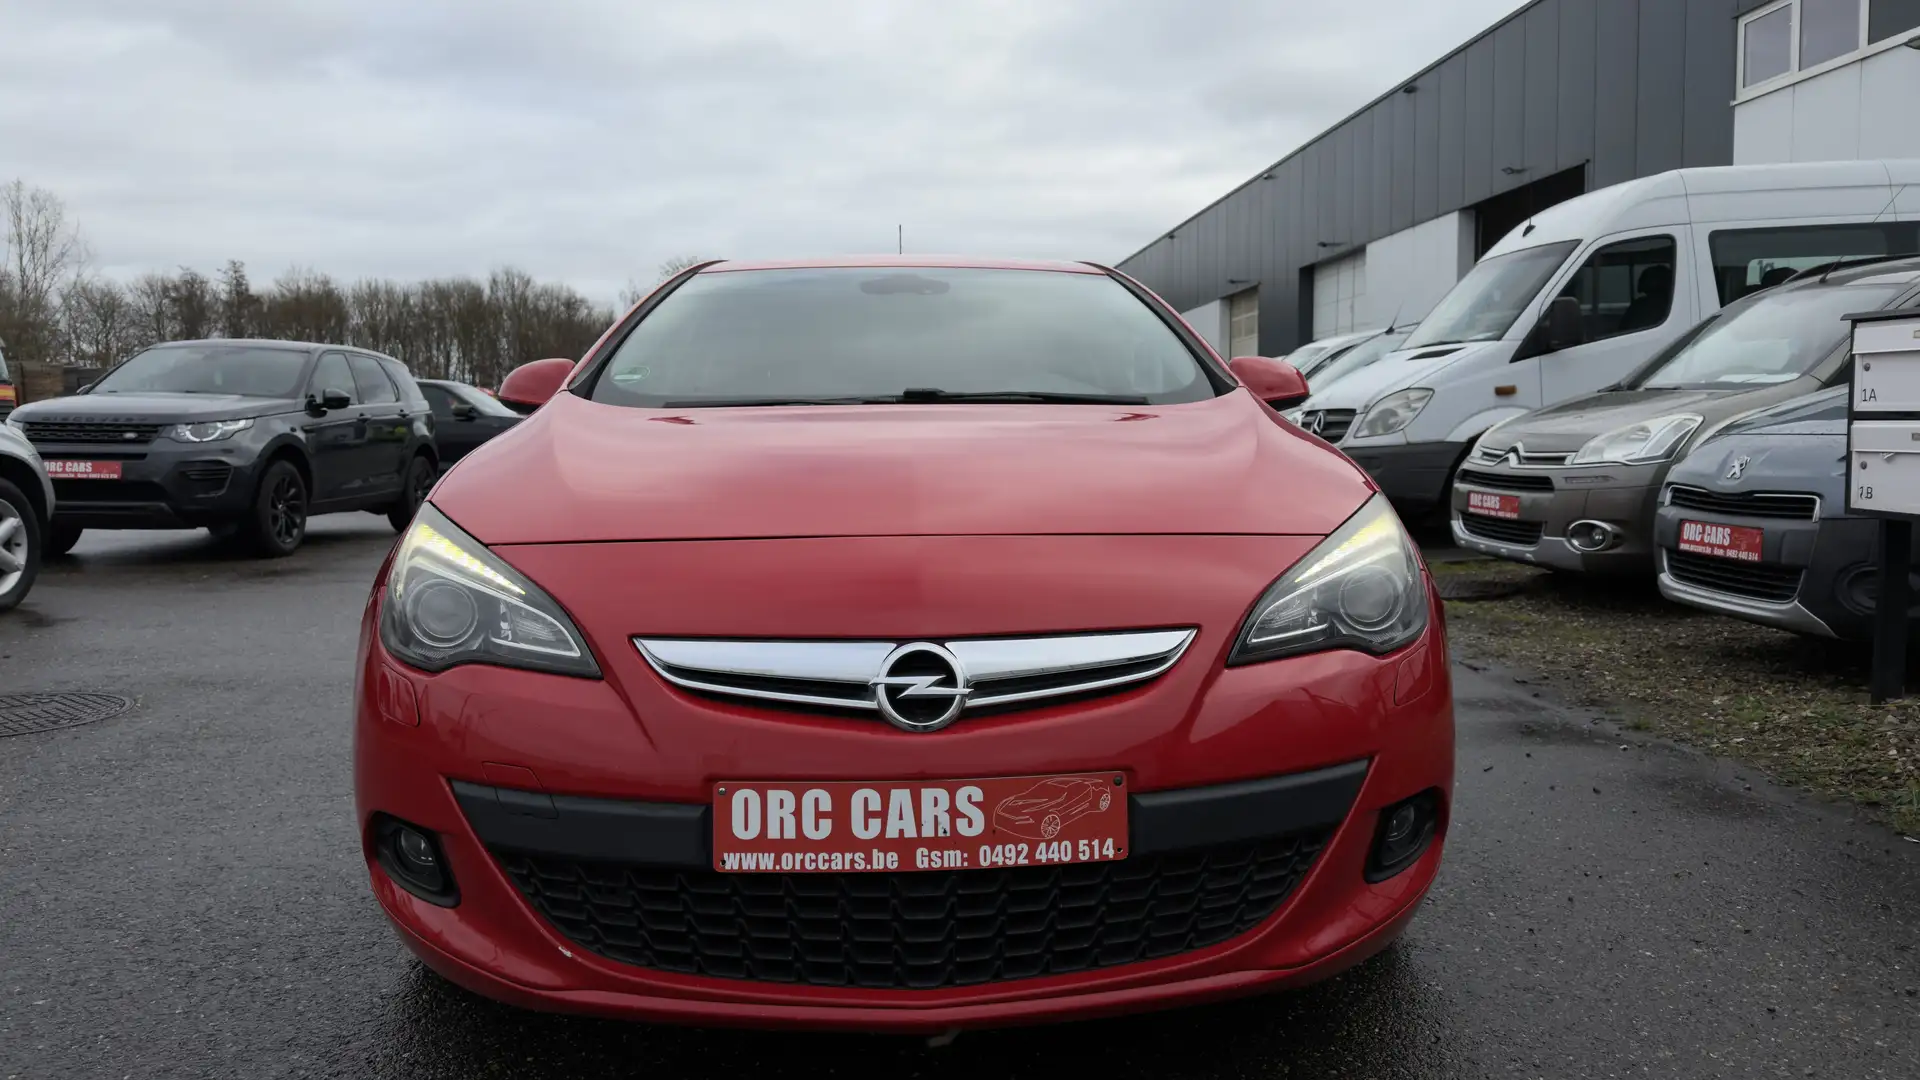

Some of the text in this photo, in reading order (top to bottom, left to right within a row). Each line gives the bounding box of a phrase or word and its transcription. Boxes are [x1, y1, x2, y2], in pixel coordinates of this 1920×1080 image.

[1862, 388, 1877, 402] 1A
[65, 461, 93, 473] CARS
[1683, 522, 1731, 546] ORC CARS
[731, 785, 985, 840] ORC CARS
[723, 837, 1115, 870] www.orccars.be Gsm: 0492 440 514
